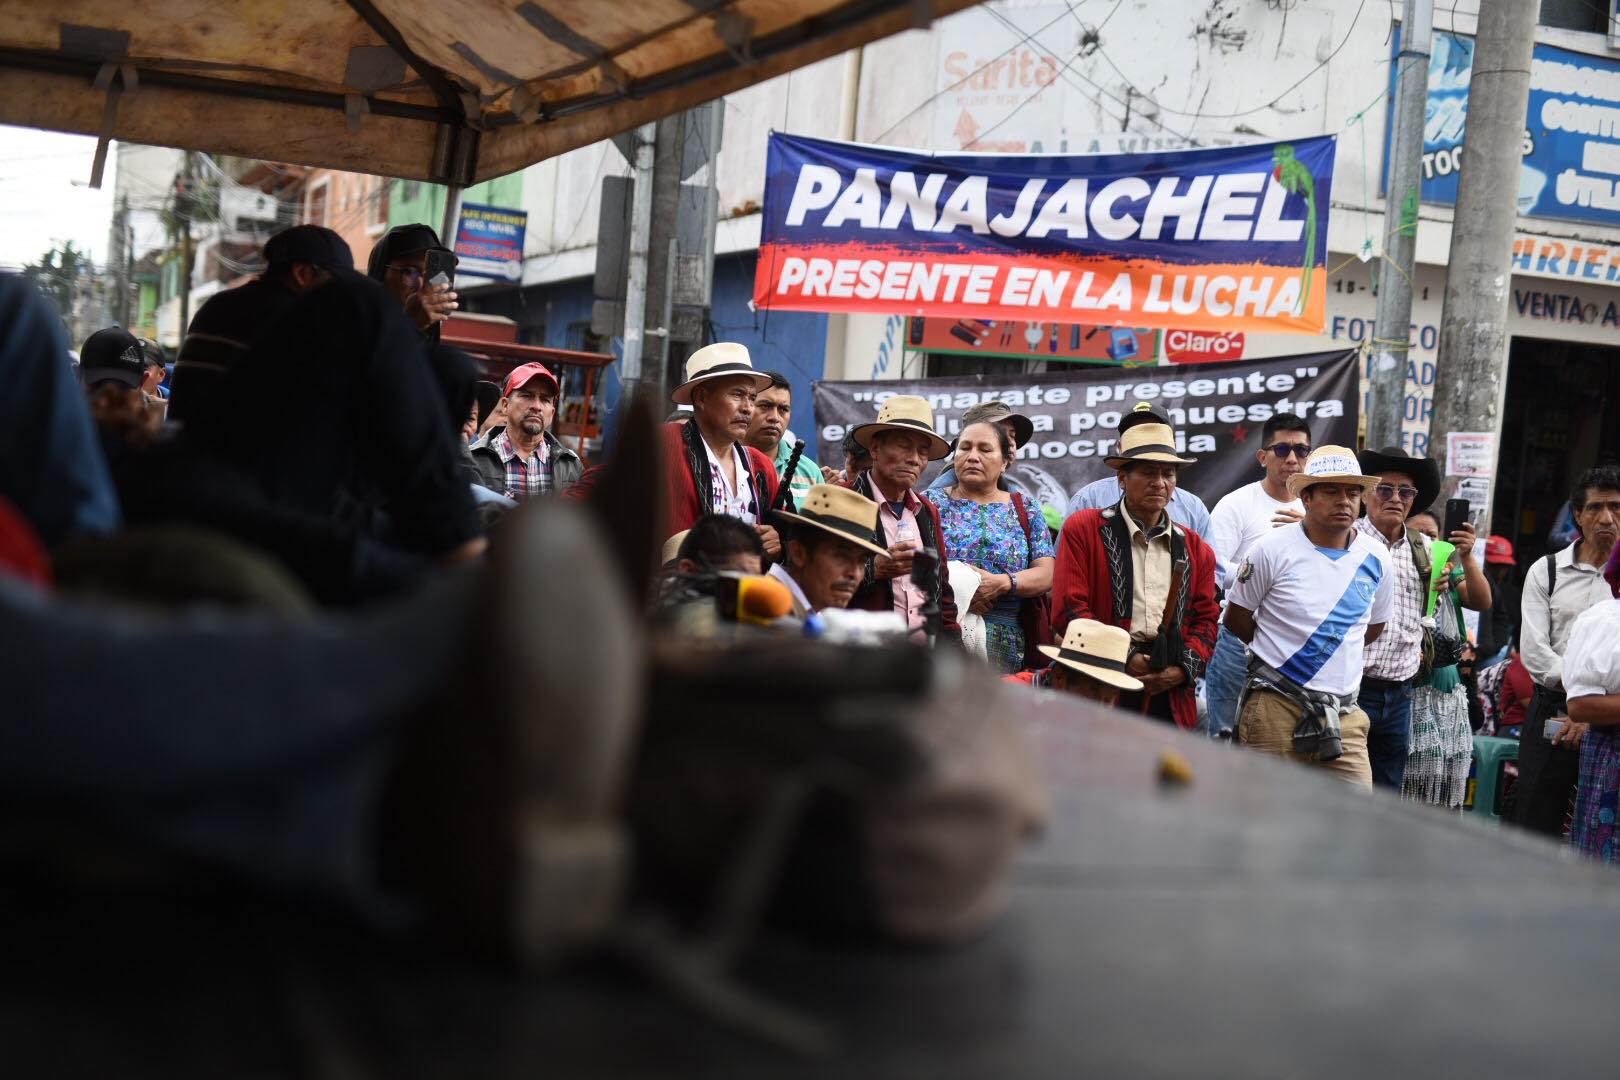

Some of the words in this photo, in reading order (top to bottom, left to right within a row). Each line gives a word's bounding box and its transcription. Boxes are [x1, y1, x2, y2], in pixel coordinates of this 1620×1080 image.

[943, 48, 1057, 93] Sarita
[785, 163, 1305, 242] PANAJACHEL
[777, 257, 999, 304] PRESENTE
[1000, 266, 1072, 308] EN
[1071, 270, 1133, 313] LA
[1142, 274, 1304, 318] LUCHA
[1514, 289, 1585, 324] VENTA
[853, 384, 1071, 412] "Snarate
[1085, 367, 1319, 407] presente"
[1071, 410, 1122, 435] po
[1166, 397, 1344, 426] nuestra
